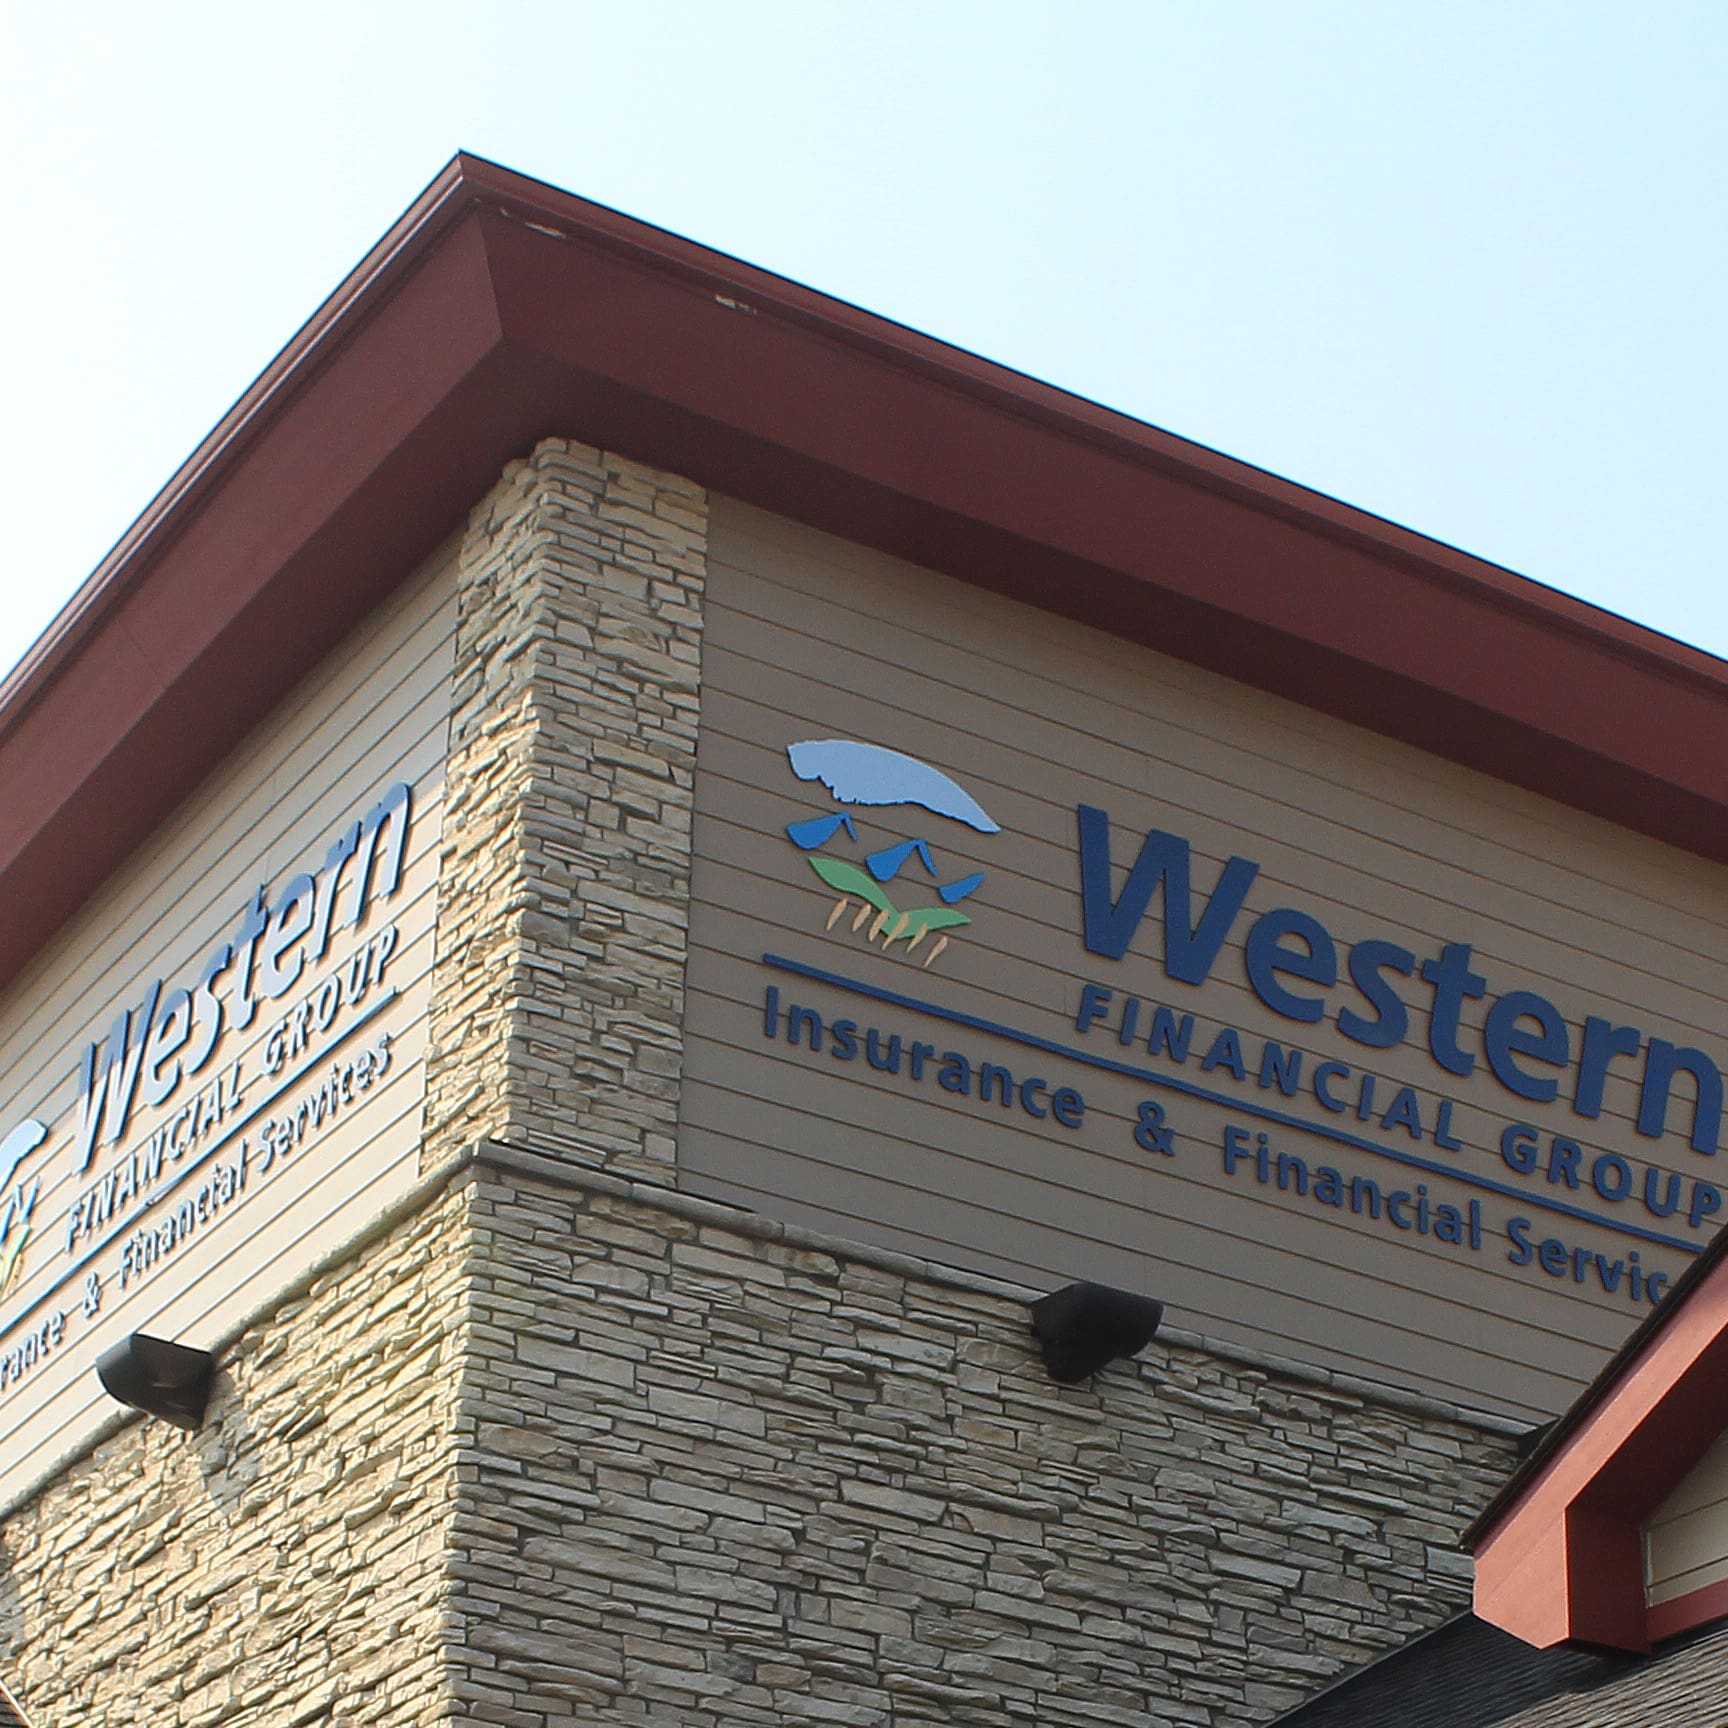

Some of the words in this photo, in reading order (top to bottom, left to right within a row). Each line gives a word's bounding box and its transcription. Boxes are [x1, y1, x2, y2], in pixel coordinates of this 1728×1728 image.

[65, 1059, 243, 1254] FINANCIAL
[262, 923, 399, 1076] GROUP
[72, 782, 410, 1177] Western
[765, 985, 1085, 1128] Insurance
[1135, 1100, 1175, 1156] &
[1223, 1124, 1482, 1250] Financial
[1077, 804, 1724, 1156] Western
[1077, 984, 1462, 1151] FINANCIAL
[1501, 1123, 1722, 1228] GROUP
[82, 1270, 102, 1318] &
[118, 1137, 249, 1290] Financial
[256, 1032, 393, 1174] Services
